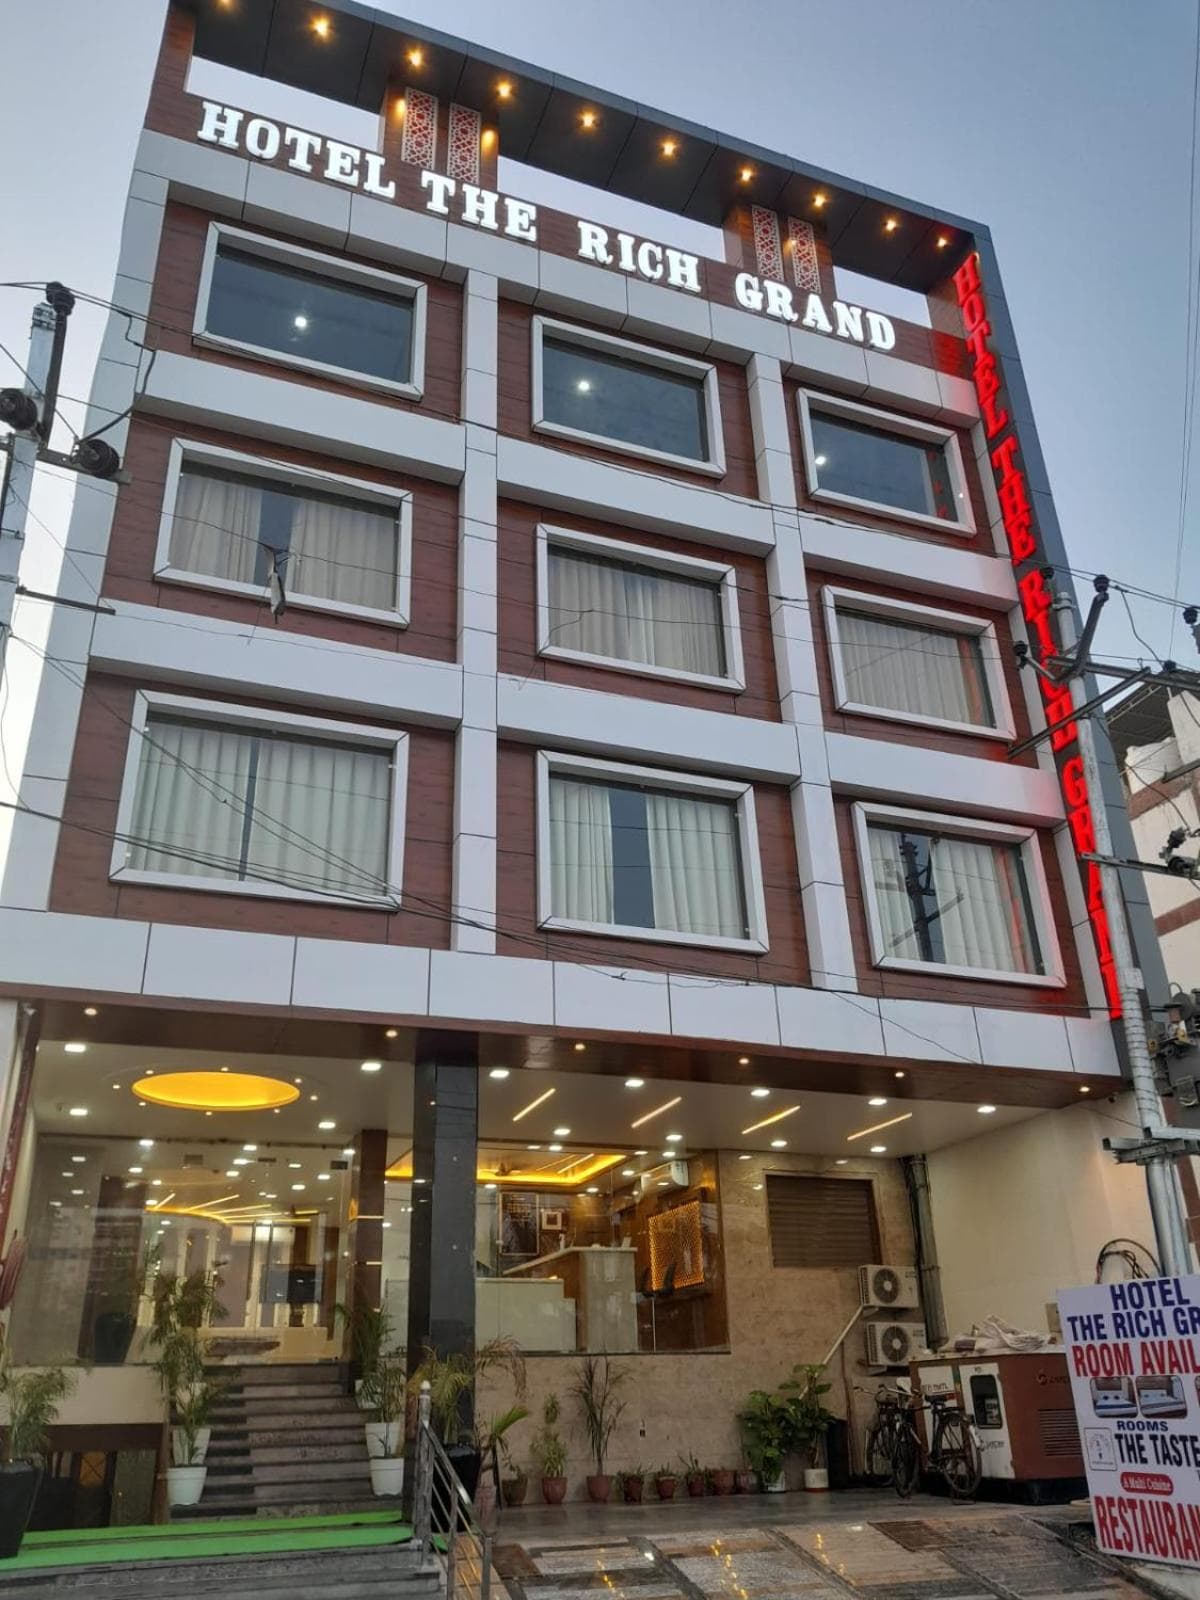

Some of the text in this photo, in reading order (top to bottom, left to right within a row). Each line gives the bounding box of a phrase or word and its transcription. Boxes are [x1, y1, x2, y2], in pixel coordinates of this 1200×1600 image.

[196, 100, 897, 352] HOTEL THE RICH GRAND
[952, 252, 1010, 440] HOTEL
[991, 434, 1037, 567] THE
[1110, 1277, 1191, 1311] HOTEL
[1067, 1313, 1108, 1342] THE
[1112, 1308, 1168, 1340] RICH
[1072, 1338, 1200, 1378] ROOM AVAIL
[1116, 1420, 1169, 1432] ROOMS
[1114, 1433, 1200, 1468] THE TASTE
